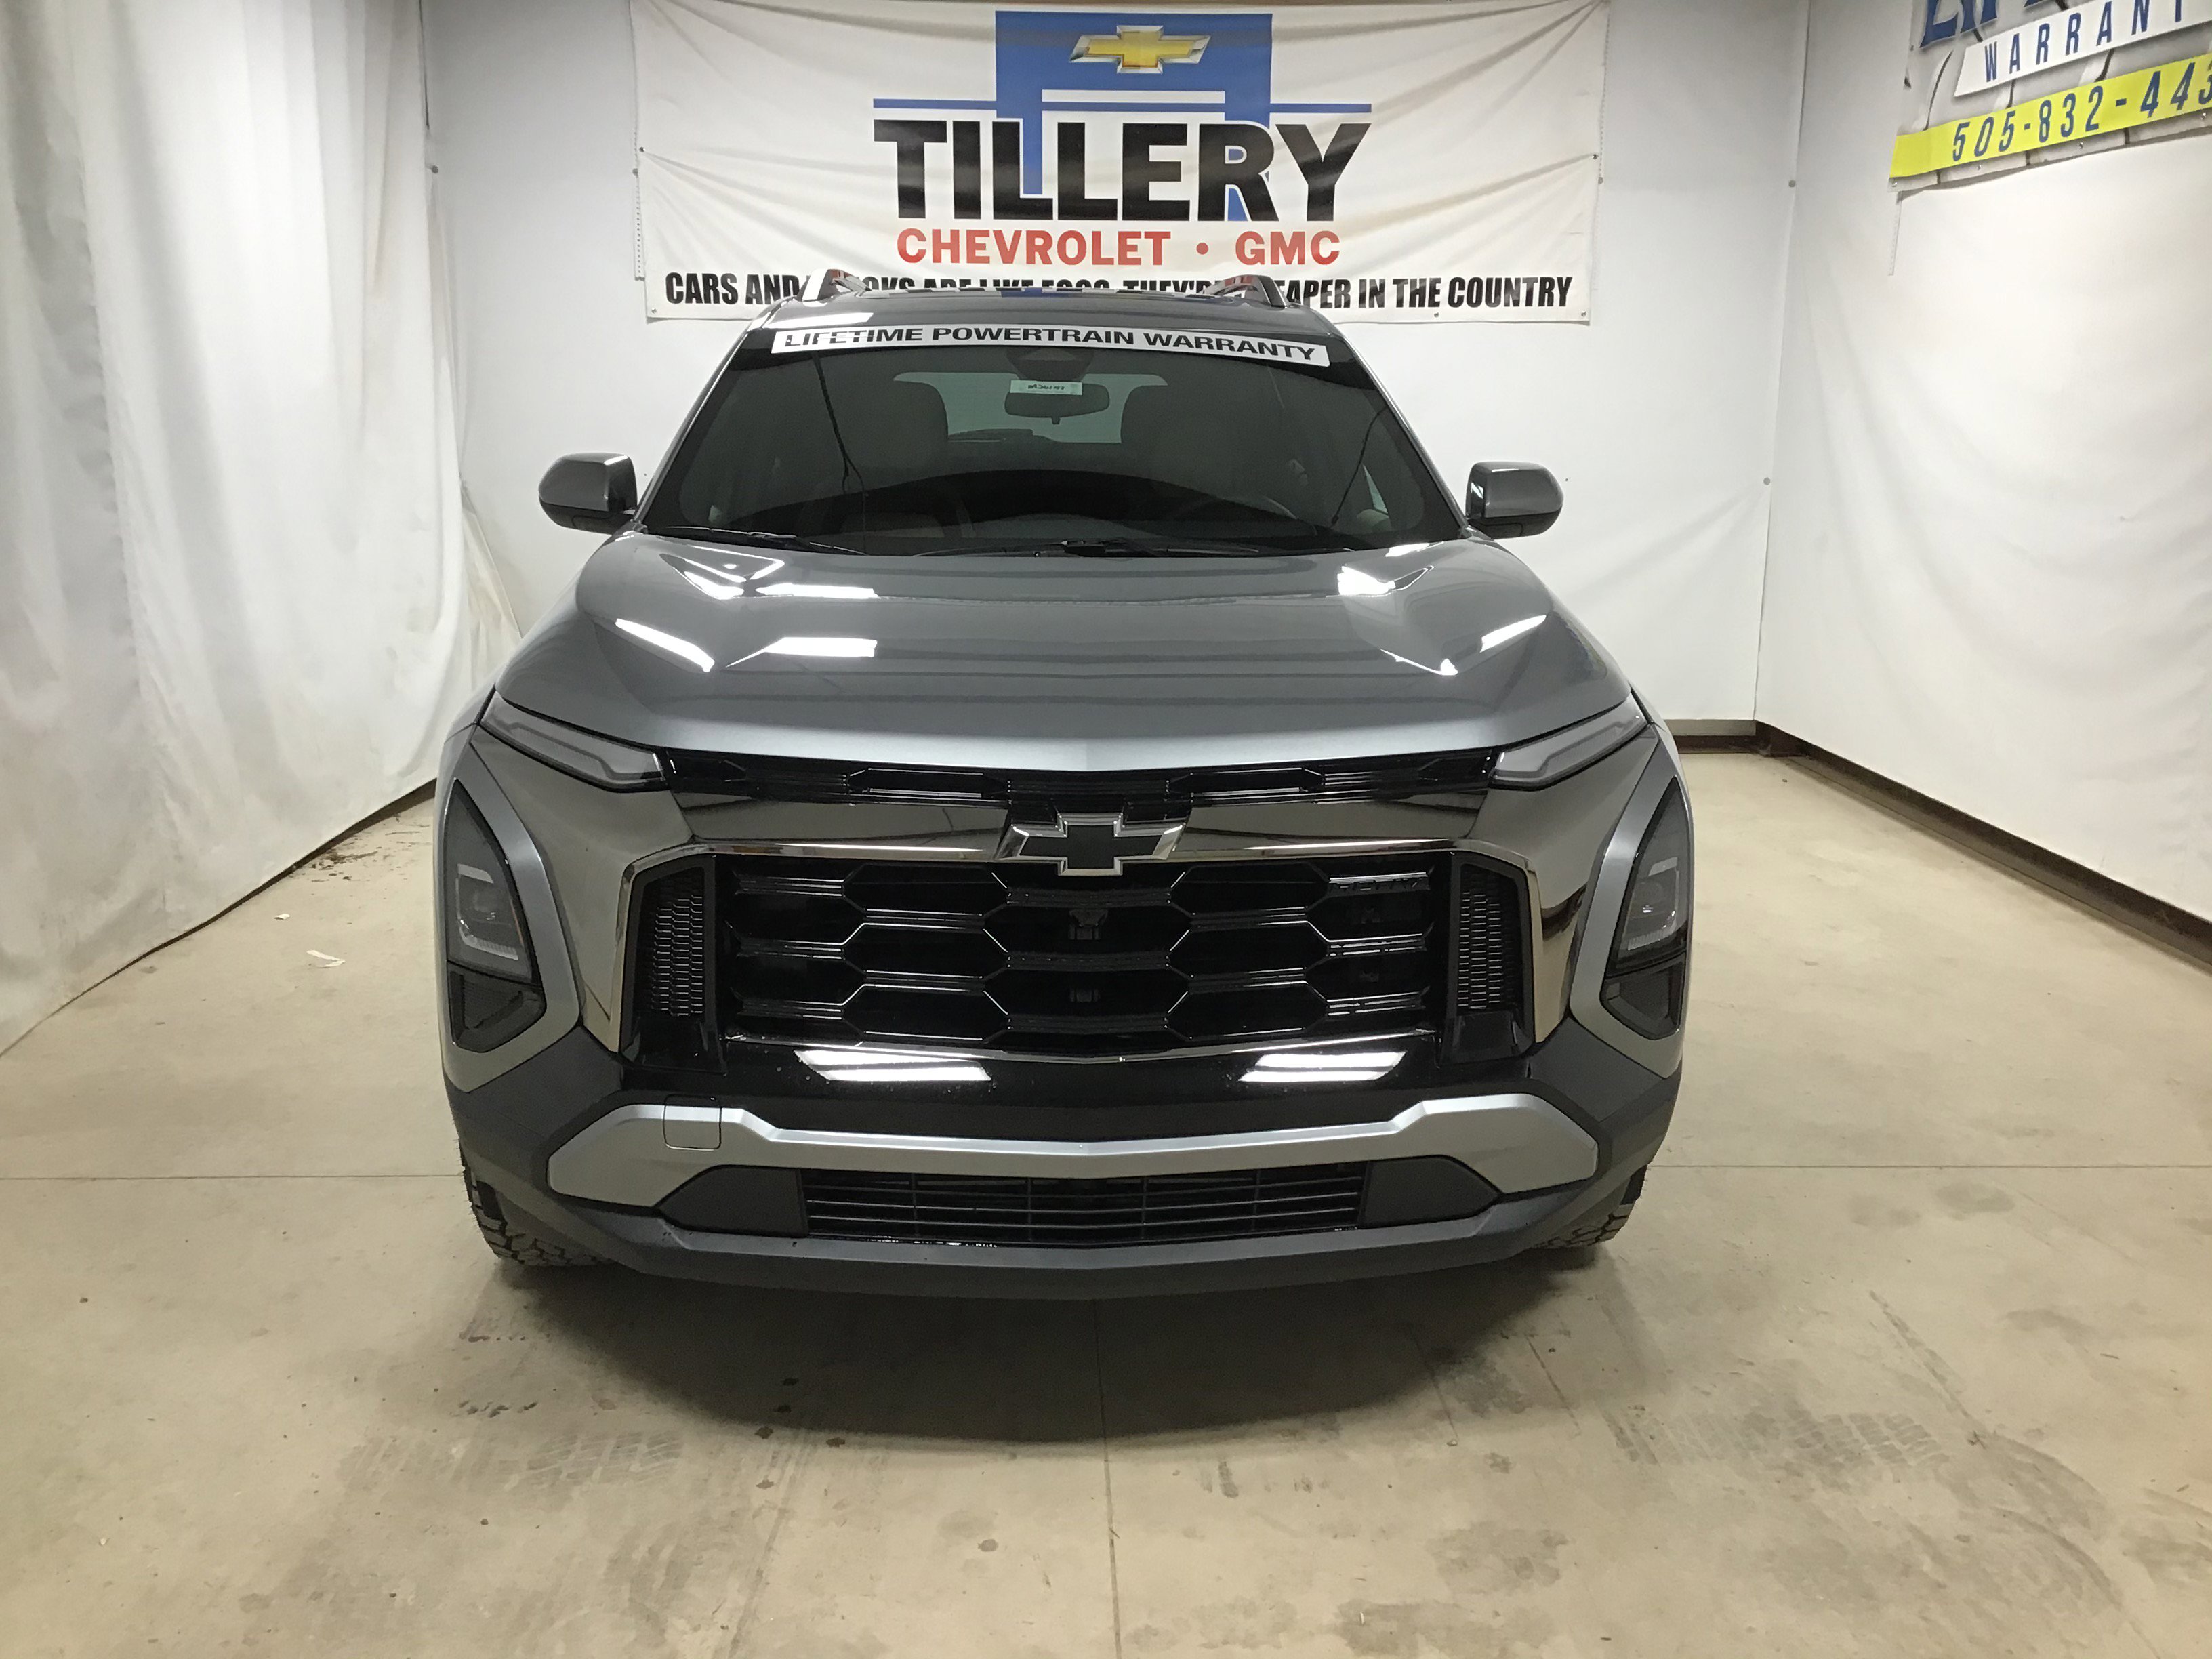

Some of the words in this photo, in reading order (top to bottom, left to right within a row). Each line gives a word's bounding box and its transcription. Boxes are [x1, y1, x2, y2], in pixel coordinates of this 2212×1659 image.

[874, 119, 1372, 221] TILLERY
[897, 228, 1171, 265] CHEVROLET
[1235, 230, 1340, 265] GMC
[665, 272, 739, 304] CARS
[745, 274, 800, 304] AND
[1358, 278, 1386, 308] IN
[1393, 277, 1441, 308] THE
[1448, 276, 1573, 308] COUNTRY
[785, 328, 923, 347] LIFETIME
[933, 327, 1134, 344] POWERTRAIN
[1143, 332, 1315, 360] WARRANTY
